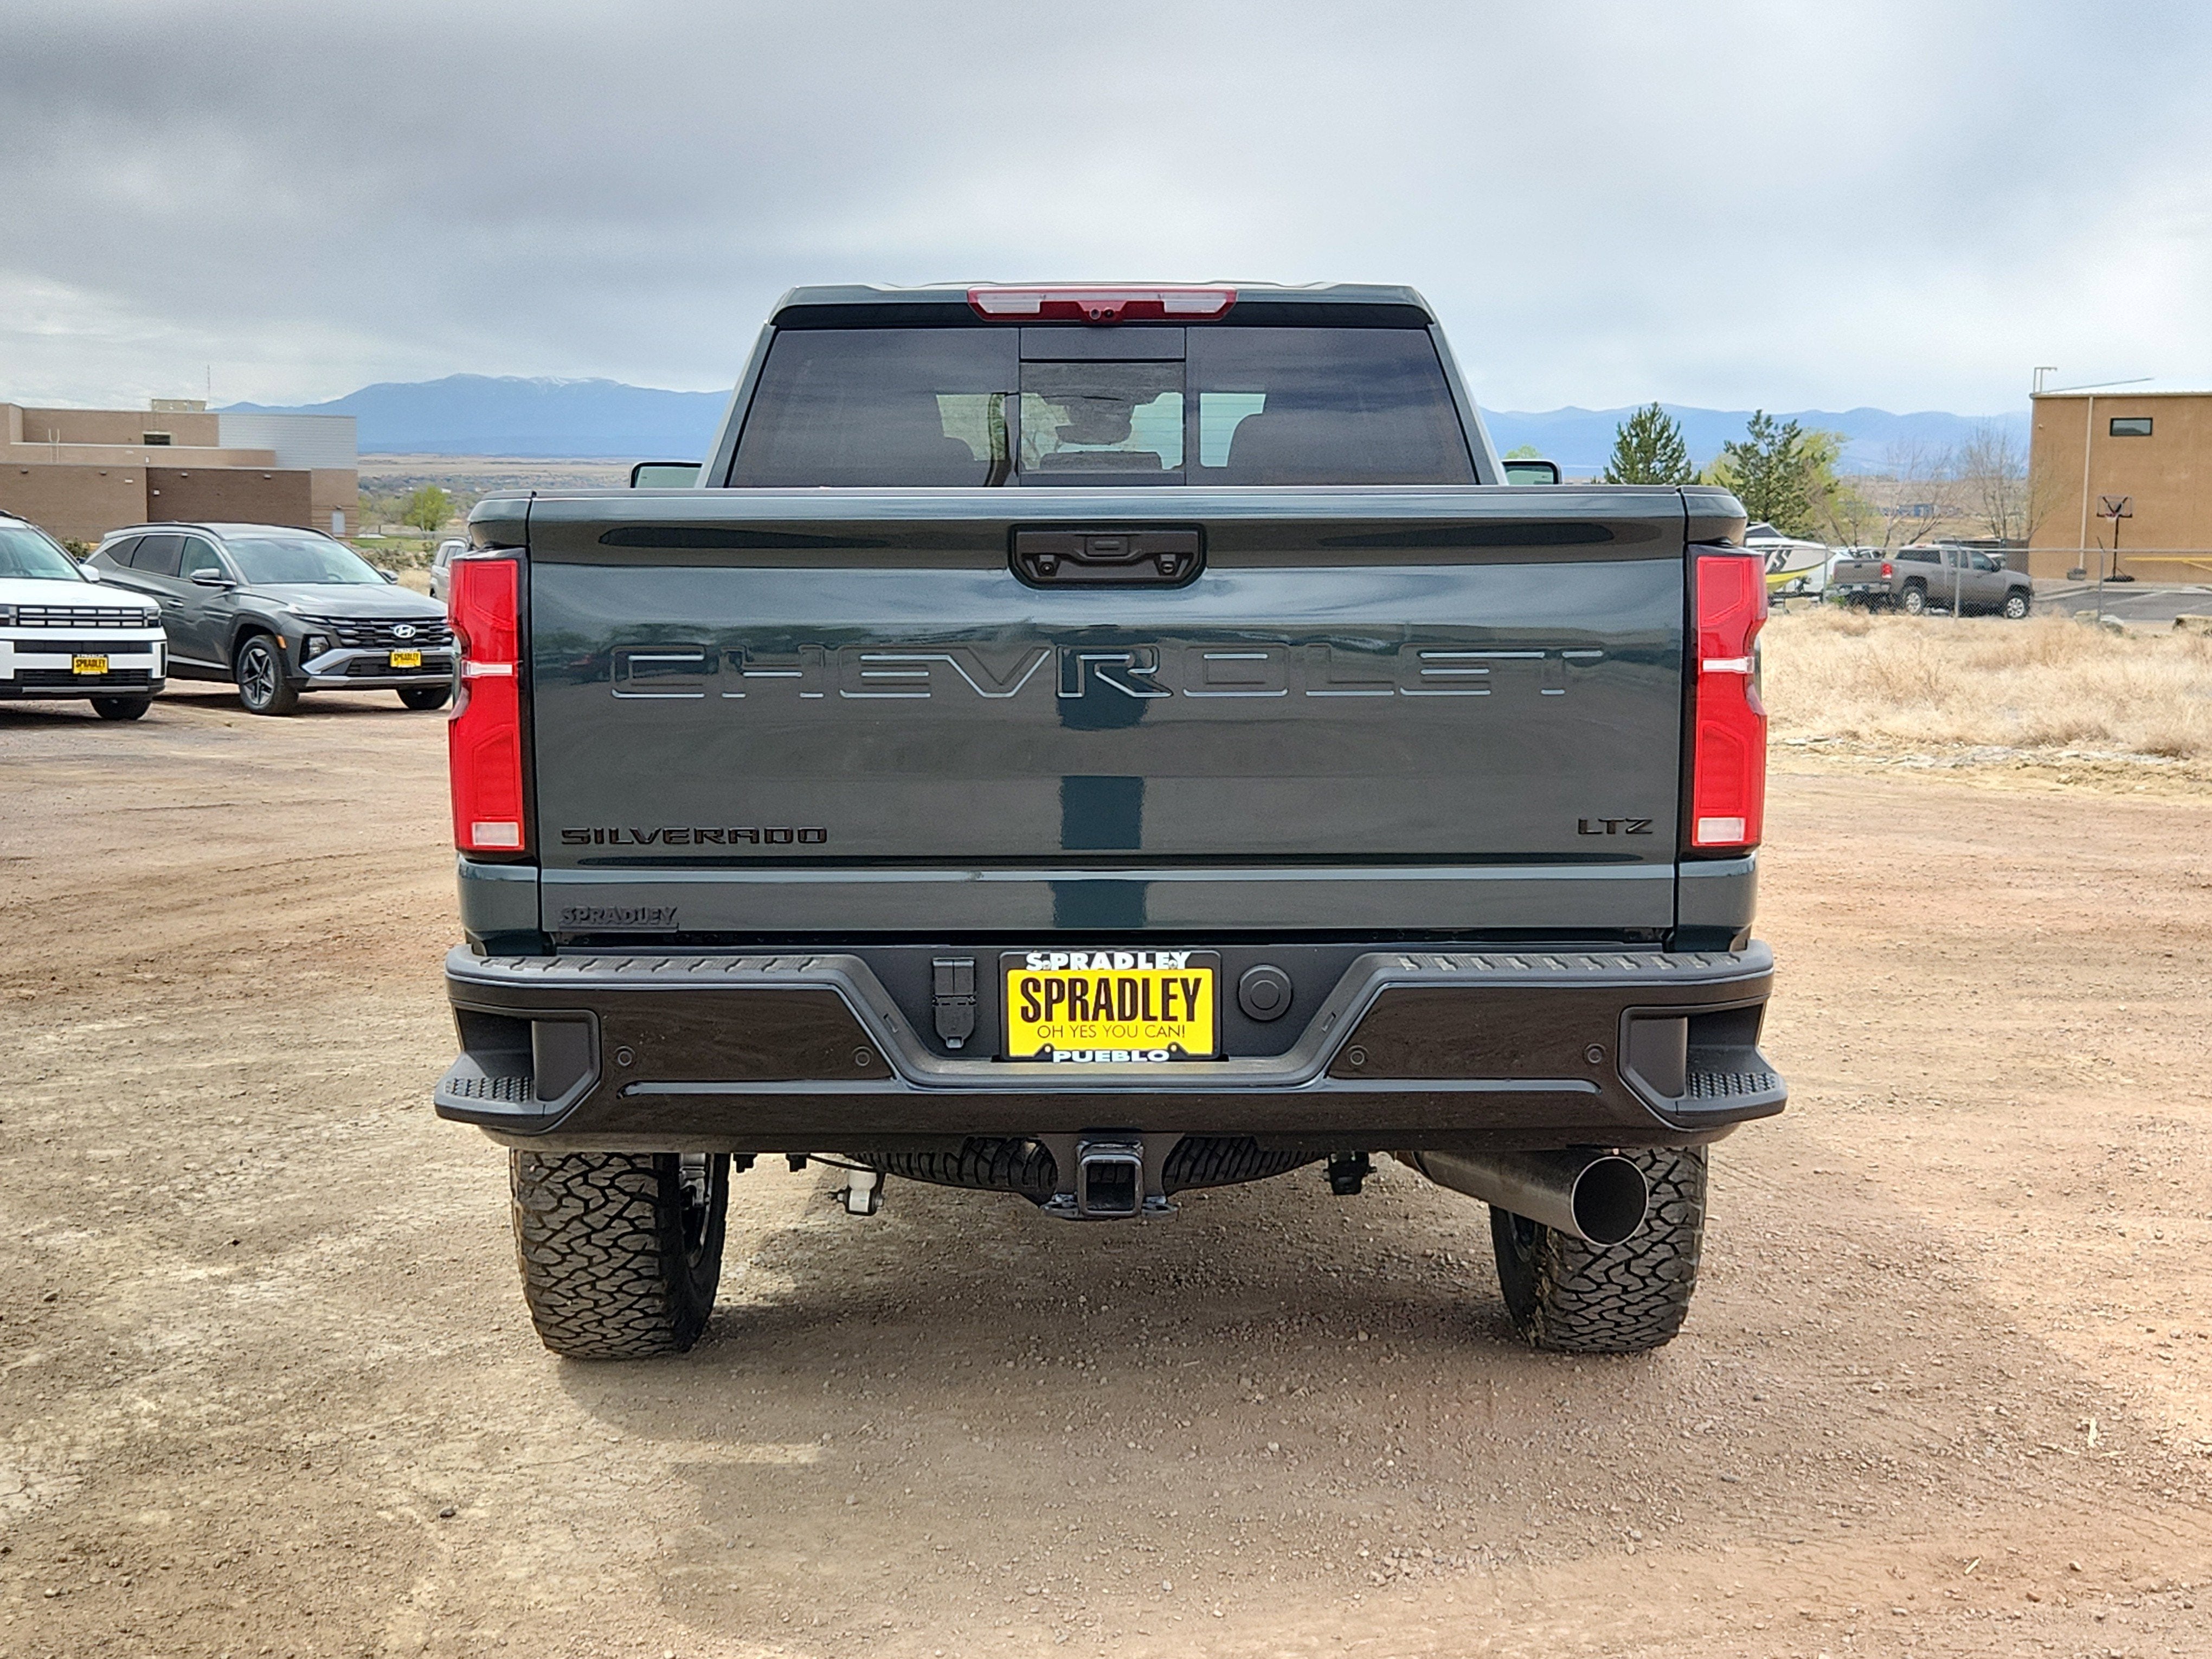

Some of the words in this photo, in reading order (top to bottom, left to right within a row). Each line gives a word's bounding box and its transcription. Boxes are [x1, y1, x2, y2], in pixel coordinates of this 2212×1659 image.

[612, 645, 1605, 699] CHEVROLET
[1578, 818, 1652, 834] LTZ
[561, 827, 827, 845] SILVERADO
[561, 906, 678, 925] SPRADLEY
[1026, 951, 1192, 970] SPRADLEY
[1020, 977, 1202, 1023] SPRADLEY
[1037, 1025, 1063, 1038] OH
[1069, 1025, 1096, 1038] YES
[1102, 1025, 1138, 1038] YOU
[1144, 1025, 1185, 1038] CAN!
[1053, 1050, 1169, 1063] PUEBLO
